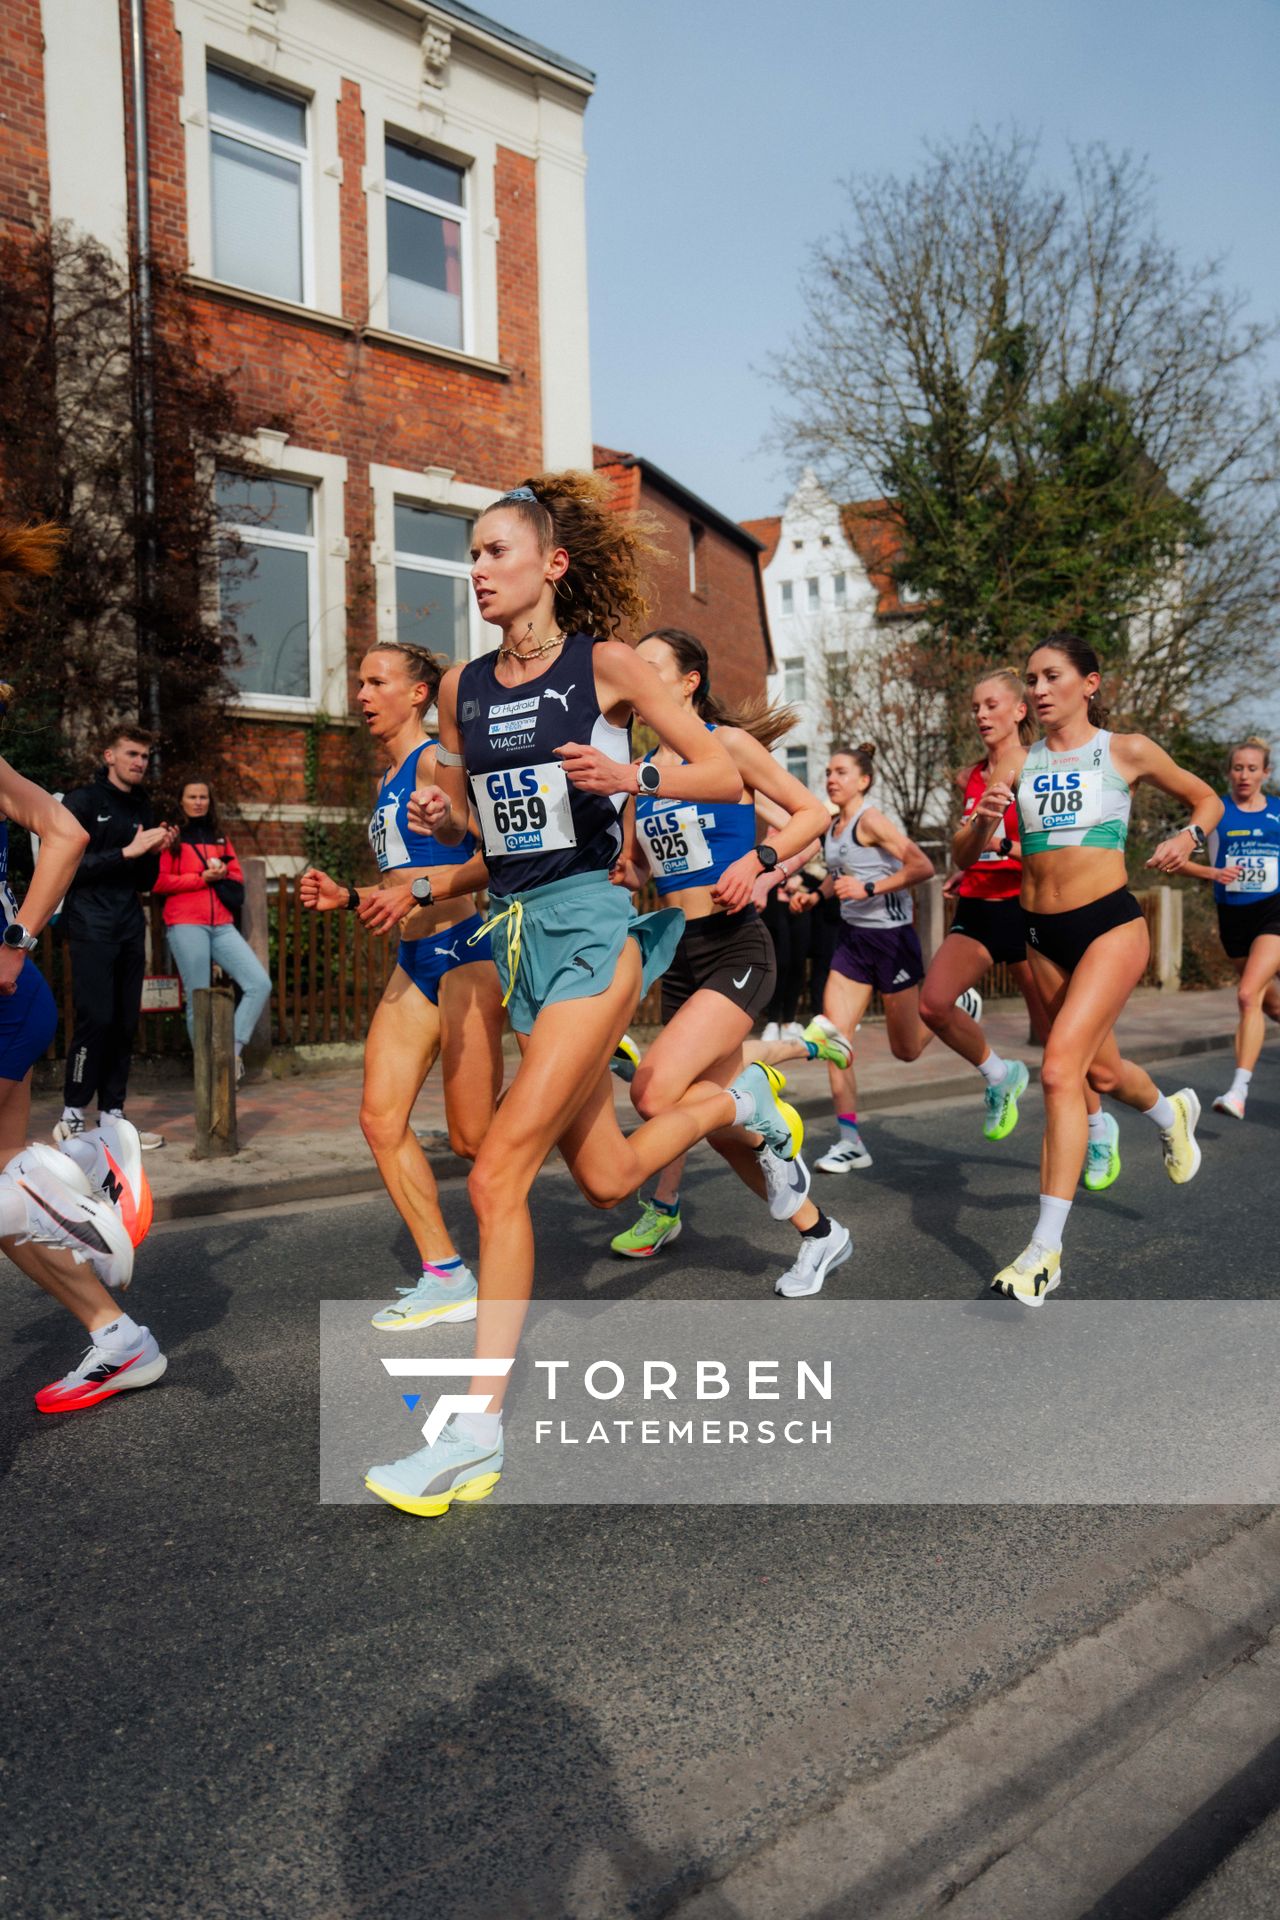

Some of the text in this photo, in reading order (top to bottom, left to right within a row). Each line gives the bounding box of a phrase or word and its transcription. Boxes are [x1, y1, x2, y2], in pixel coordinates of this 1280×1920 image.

[490, 732, 536, 749] VIACTIV
[486, 769, 538, 801] GLS
[1033, 773, 1080, 792] GLS
[1035, 790, 1082, 815] 708
[494, 797, 547, 834] 659
[643, 812, 679, 838] GLS
[1055, 814, 1074, 822] PLAN
[518, 833, 540, 844] PLAN
[650, 832, 689, 861] 925
[1236, 857, 1265, 868] GLS
[1237, 868, 1267, 882] 929
